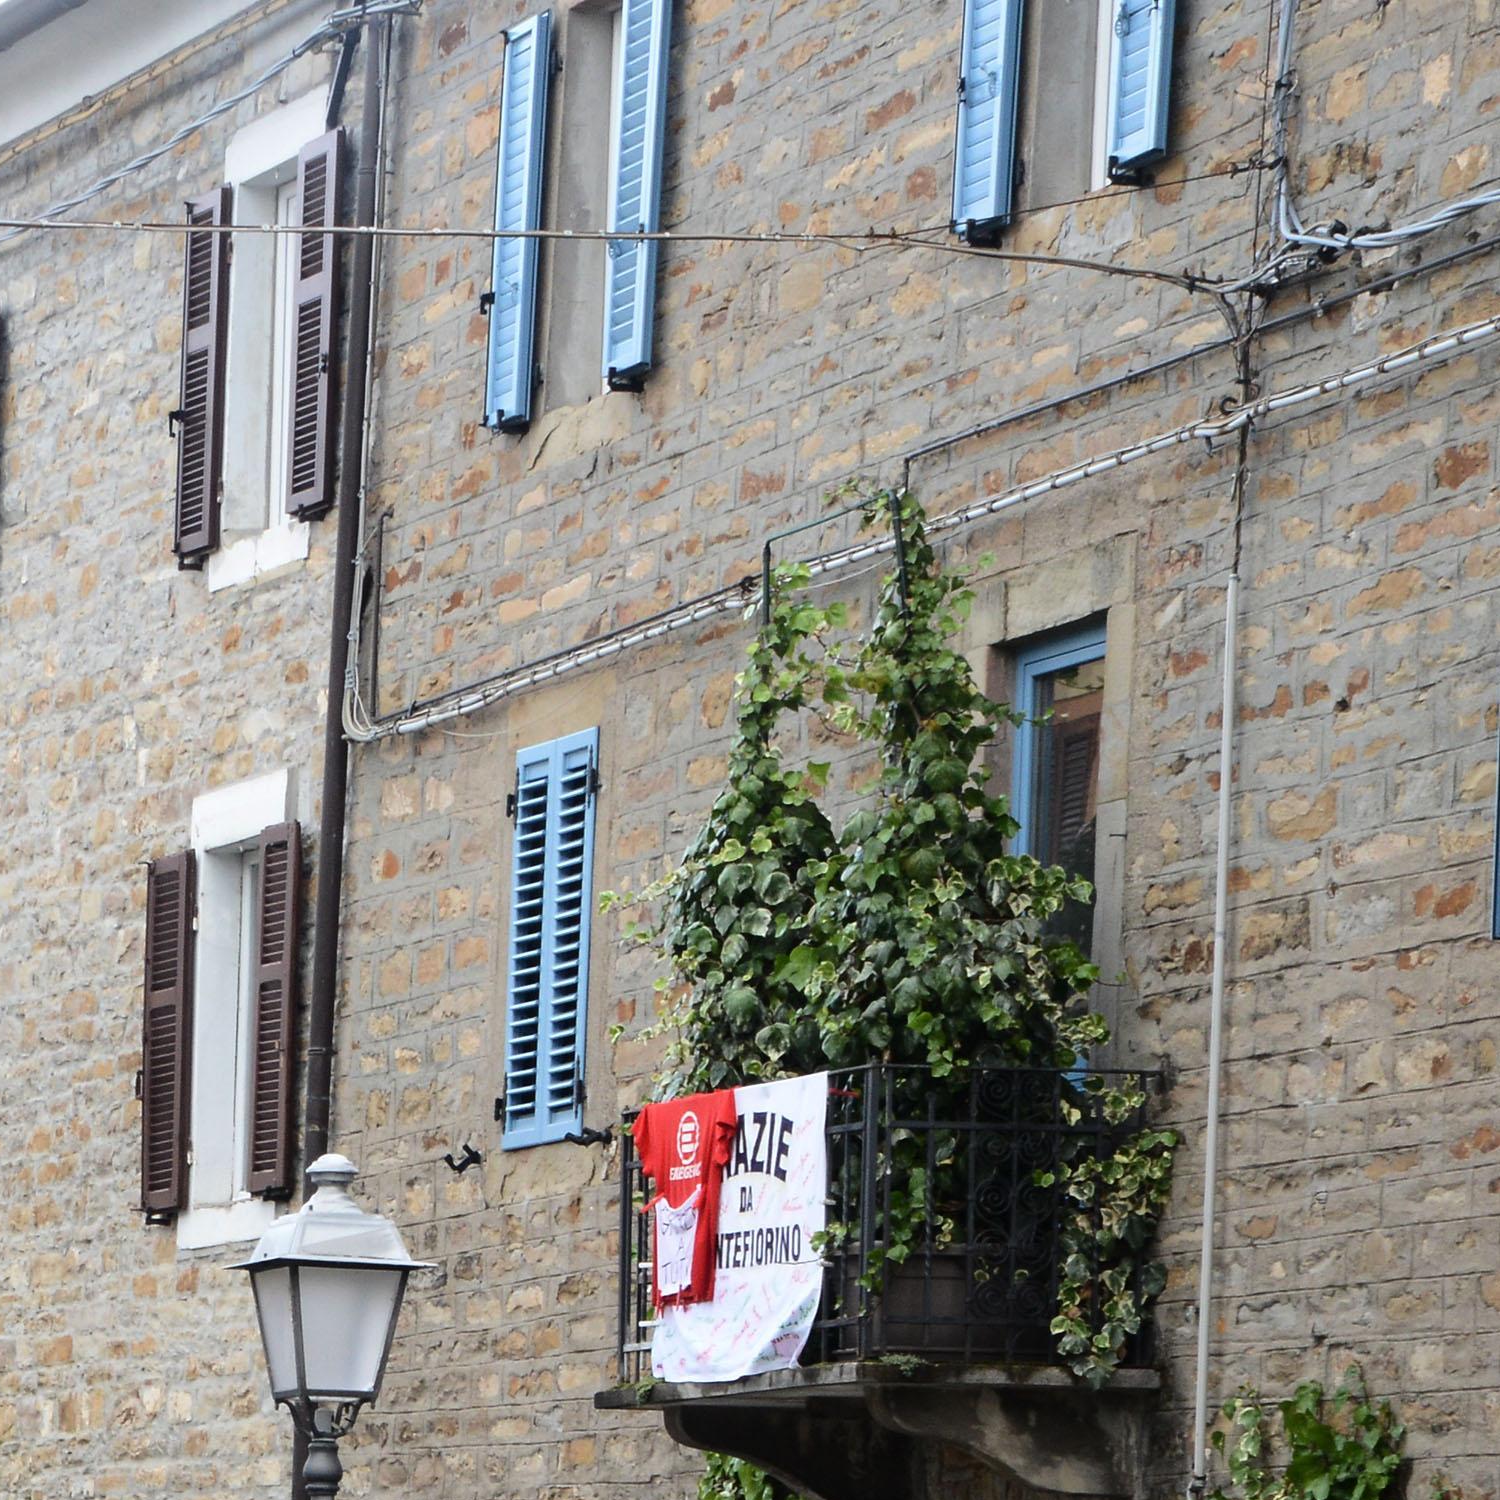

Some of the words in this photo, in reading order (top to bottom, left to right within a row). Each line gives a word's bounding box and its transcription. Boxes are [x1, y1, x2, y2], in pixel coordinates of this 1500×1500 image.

[721, 1112, 794, 1183] AZIE
[740, 1186, 753, 1213] DA
[715, 1224, 801, 1269] NTEFIORINO
